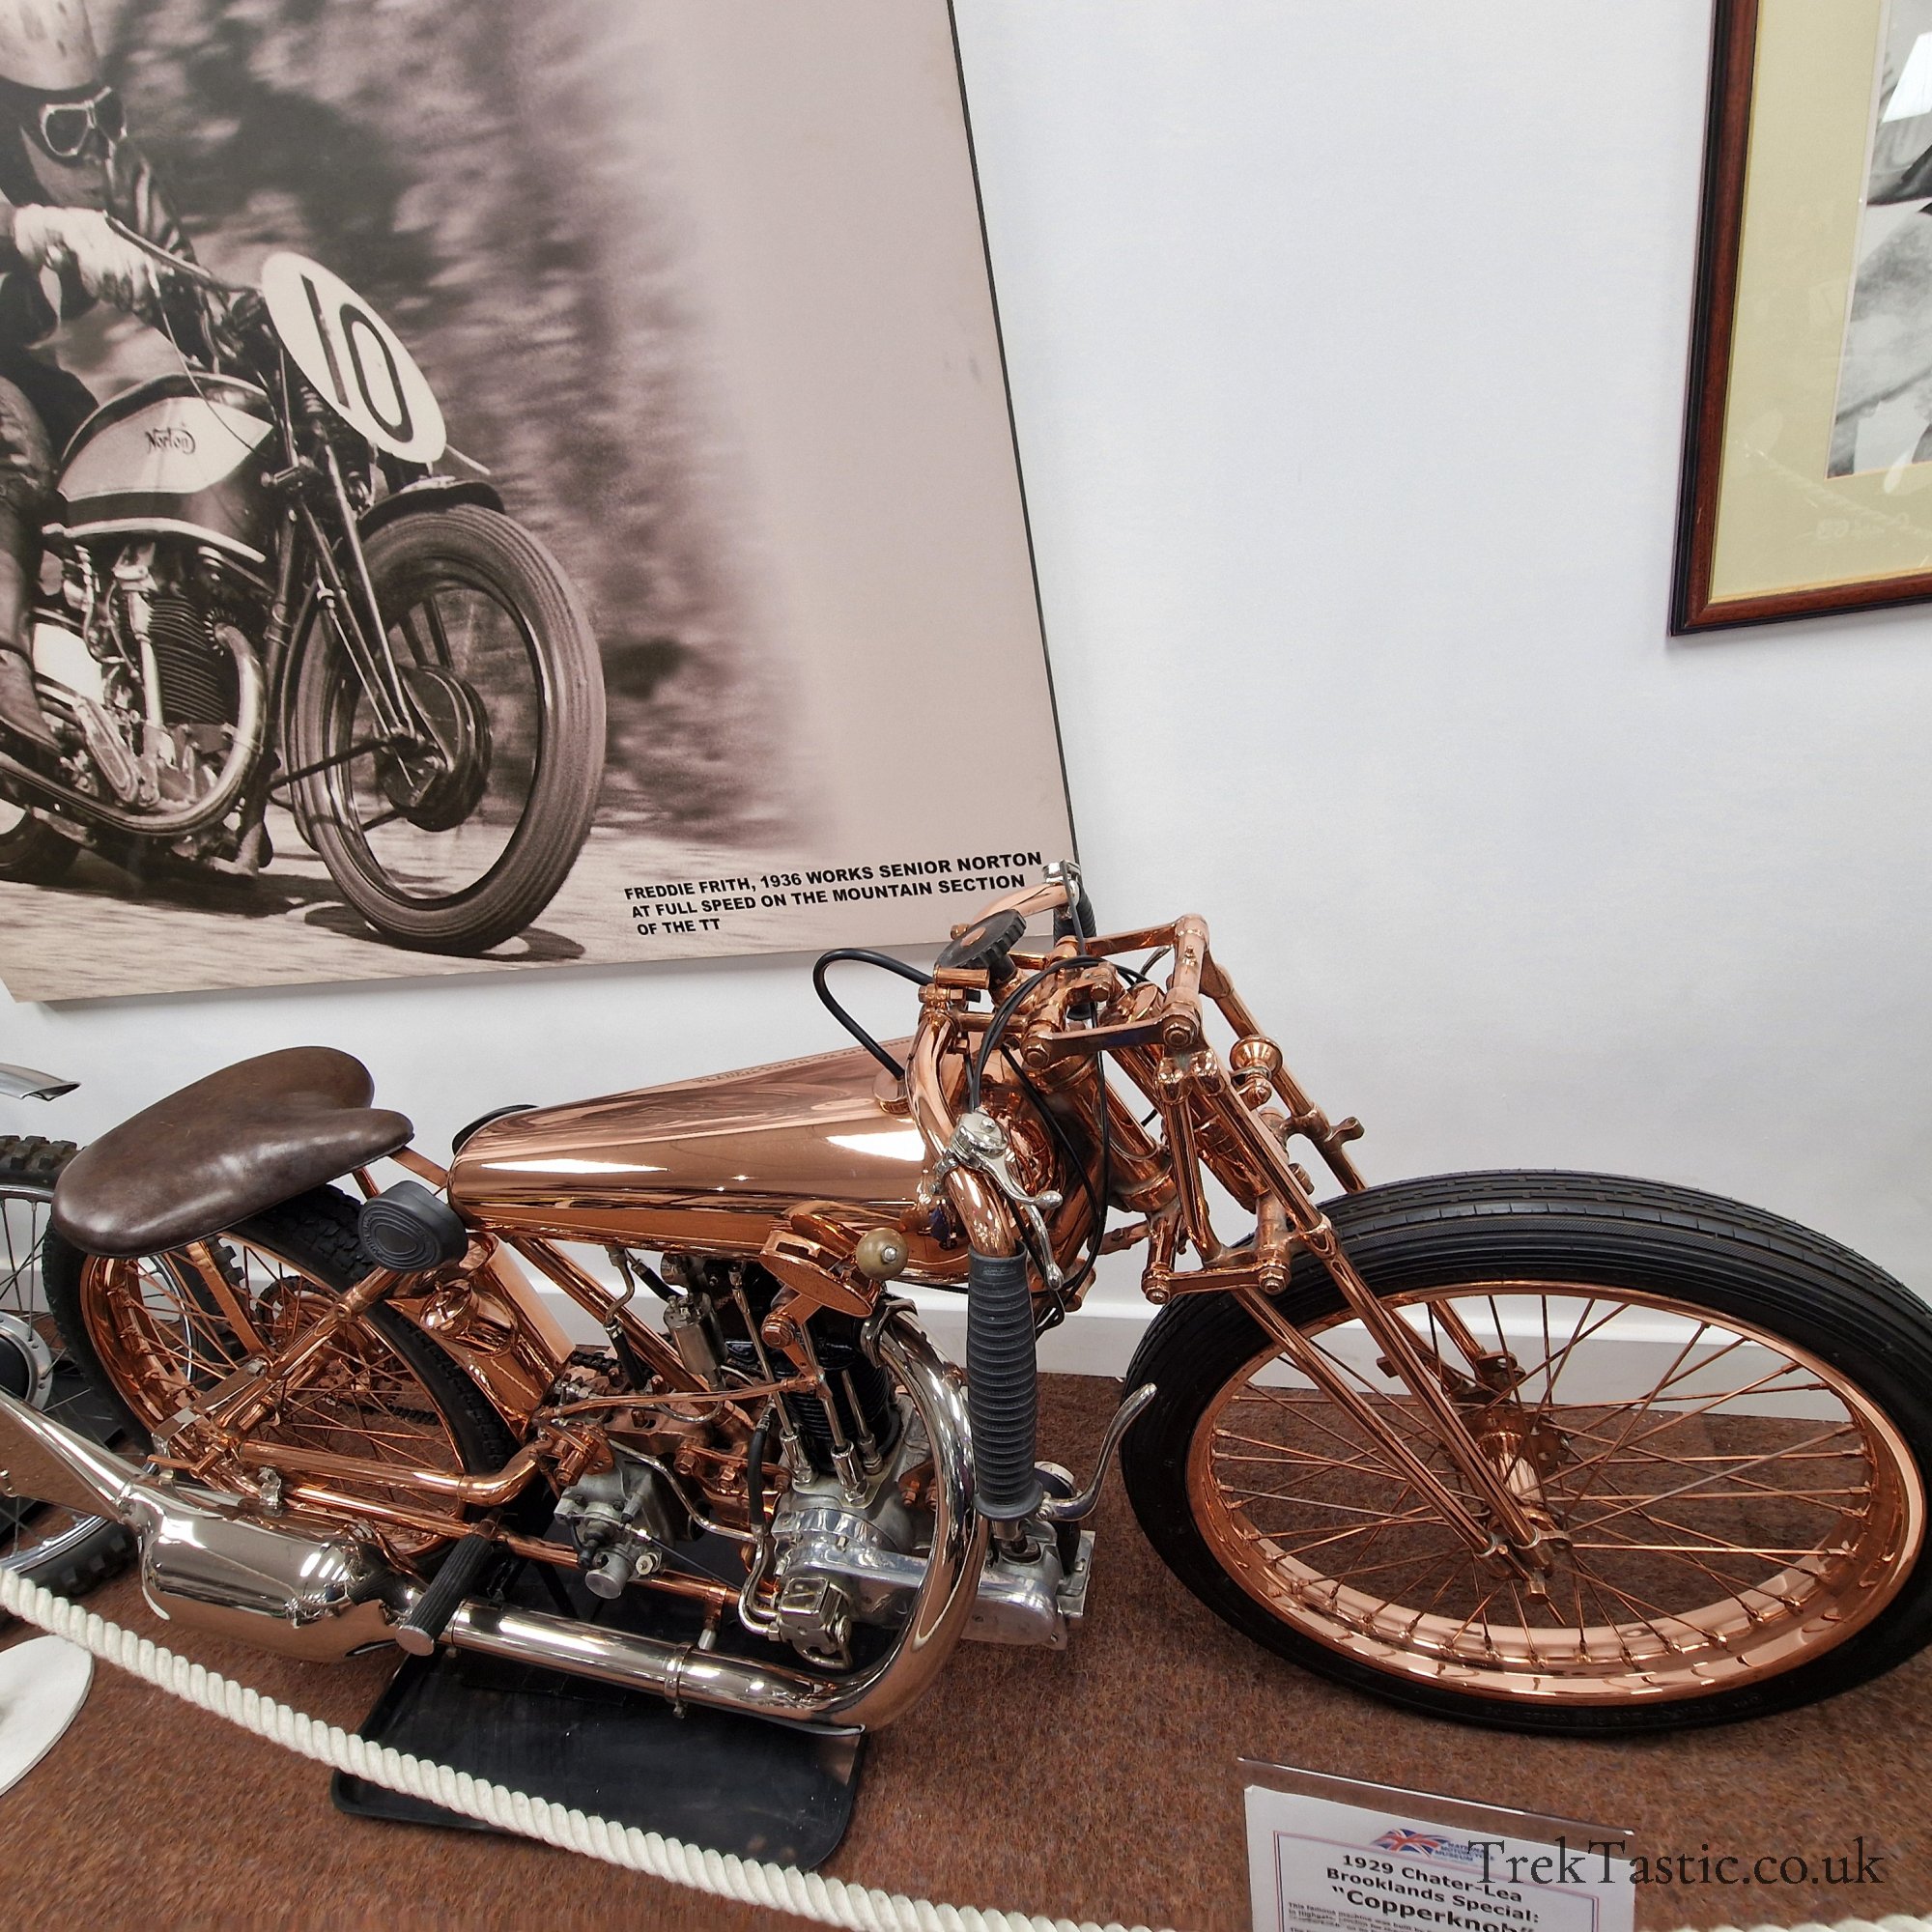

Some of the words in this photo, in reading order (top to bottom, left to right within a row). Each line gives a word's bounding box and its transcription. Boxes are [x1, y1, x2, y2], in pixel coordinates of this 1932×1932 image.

[300, 273, 413, 443] 10
[145, 426, 195, 455] Norton
[624, 882, 696, 900] FREDDIE
[698, 877, 757, 894] FRITH,
[760, 872, 803, 889] 1936
[806, 867, 874, 885] WORKS
[879, 860, 953, 878] SENIOR
[956, 851, 1042, 870] NORTON
[631, 905, 651, 919] AT
[655, 901, 698, 917] FULL
[700, 896, 756, 913] SPEED
[760, 894, 787, 908] ON
[790, 891, 829, 906] THE
[833, 882, 933, 902] MOUNTAIN
[938, 874, 1026, 894] SECTION
[637, 923, 658, 936] OF
[662, 920, 696, 934] THE
[698, 918, 721, 931] TT
[1326, 1867, 1445, 1903] Brooklands
[1452, 1894, 1539, 1923] Special:
[1343, 1854, 1394, 1874] 1929
[1402, 1866, 1522, 1902] Chater-Lea
